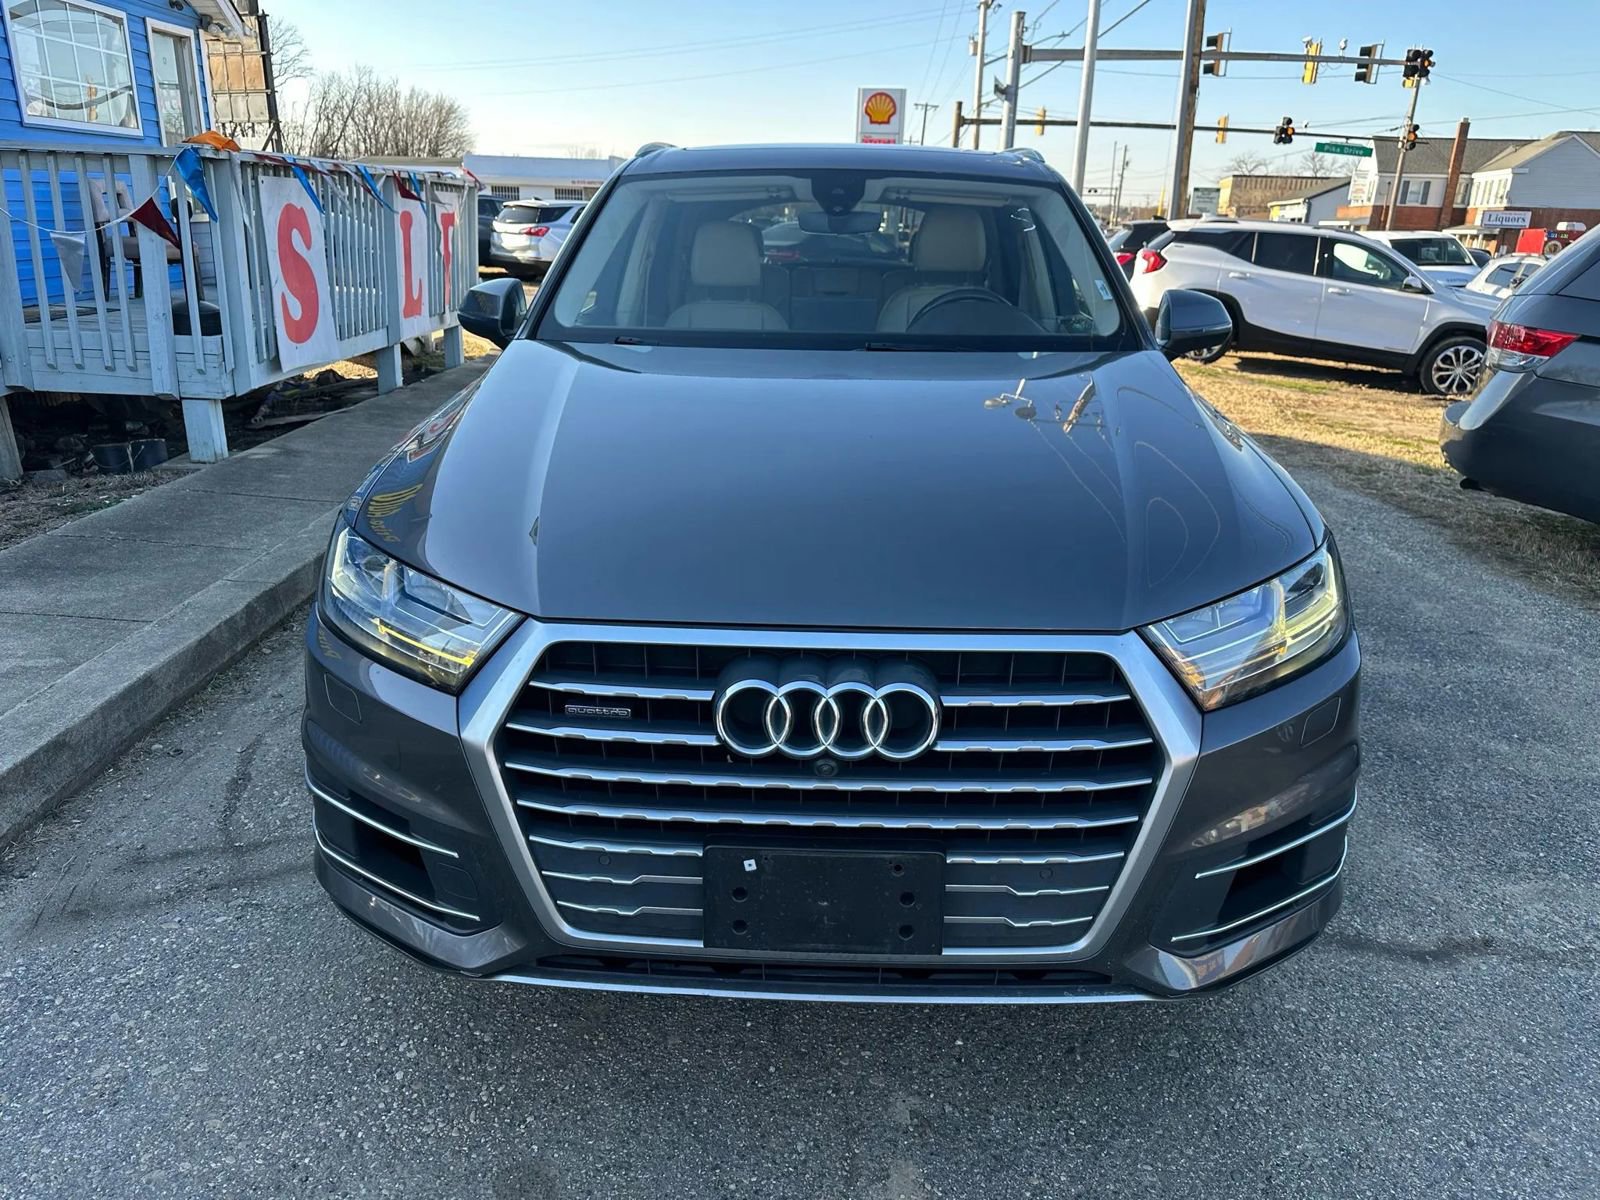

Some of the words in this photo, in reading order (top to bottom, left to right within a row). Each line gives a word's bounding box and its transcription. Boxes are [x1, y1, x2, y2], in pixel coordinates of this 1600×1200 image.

[1344, 147, 1364, 155] Drive
[1487, 213, 1527, 225] Liquors
[277, 202, 320, 344] S
[399, 210, 423, 319] L
[568, 708, 628, 716] quattro
